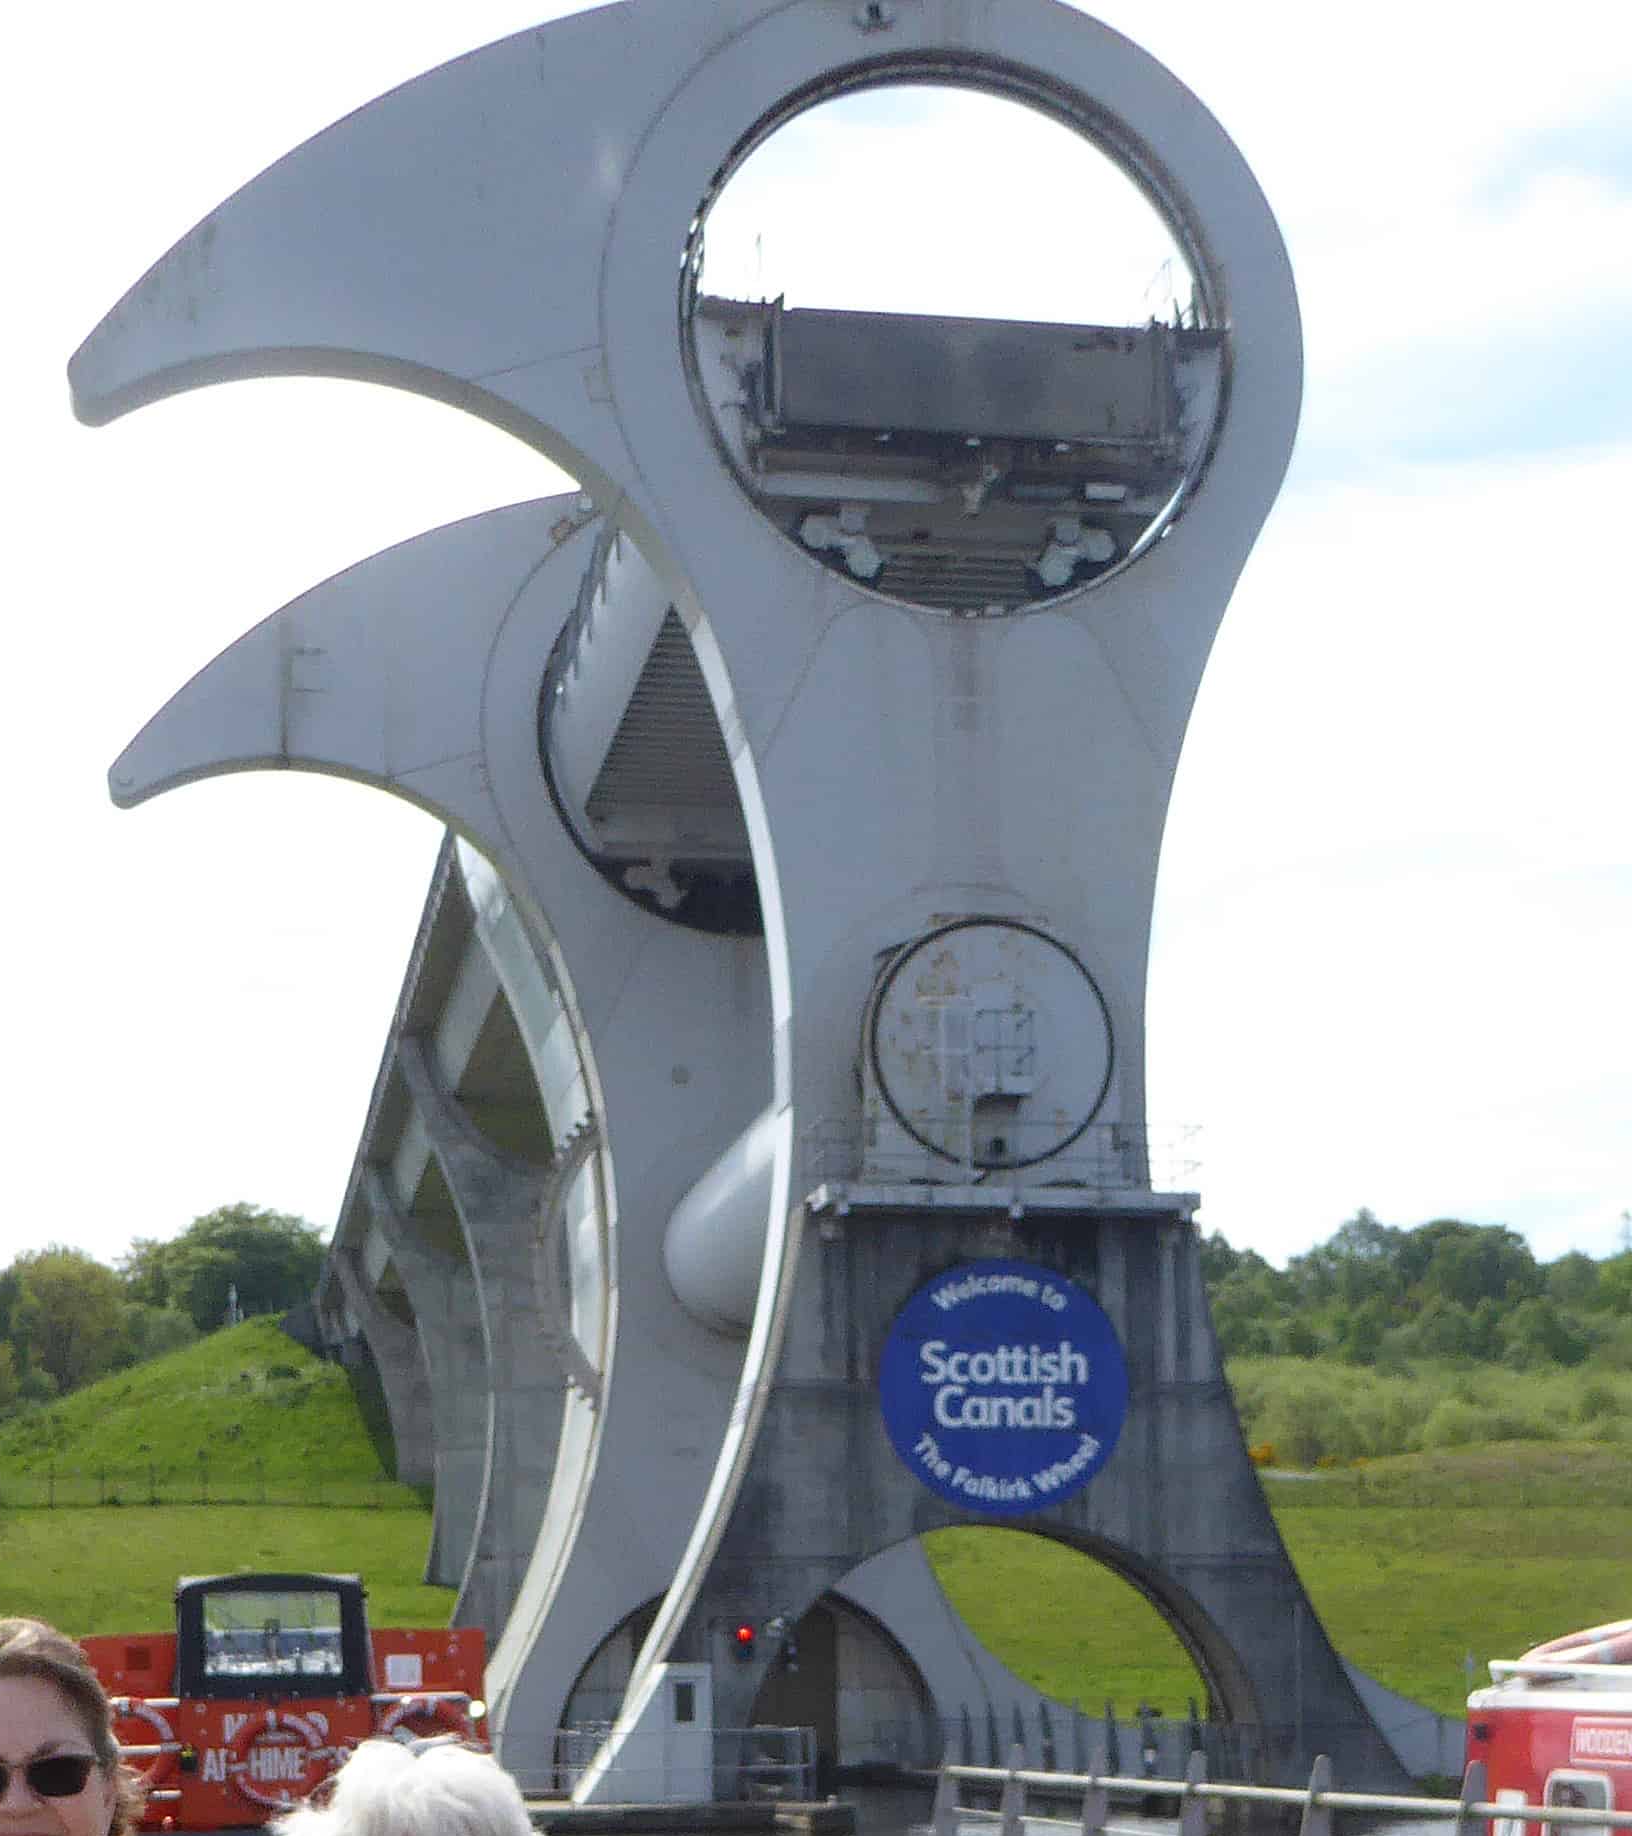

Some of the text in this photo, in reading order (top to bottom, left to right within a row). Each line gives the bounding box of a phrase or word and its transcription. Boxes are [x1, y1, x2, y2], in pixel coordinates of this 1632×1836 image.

[931, 1274, 1068, 1311] Welcome to
[919, 1340, 1089, 1384] Scottish
[933, 1384, 1076, 1429] Canals
[915, 1431, 1102, 1500] The Falkirk Wheel
